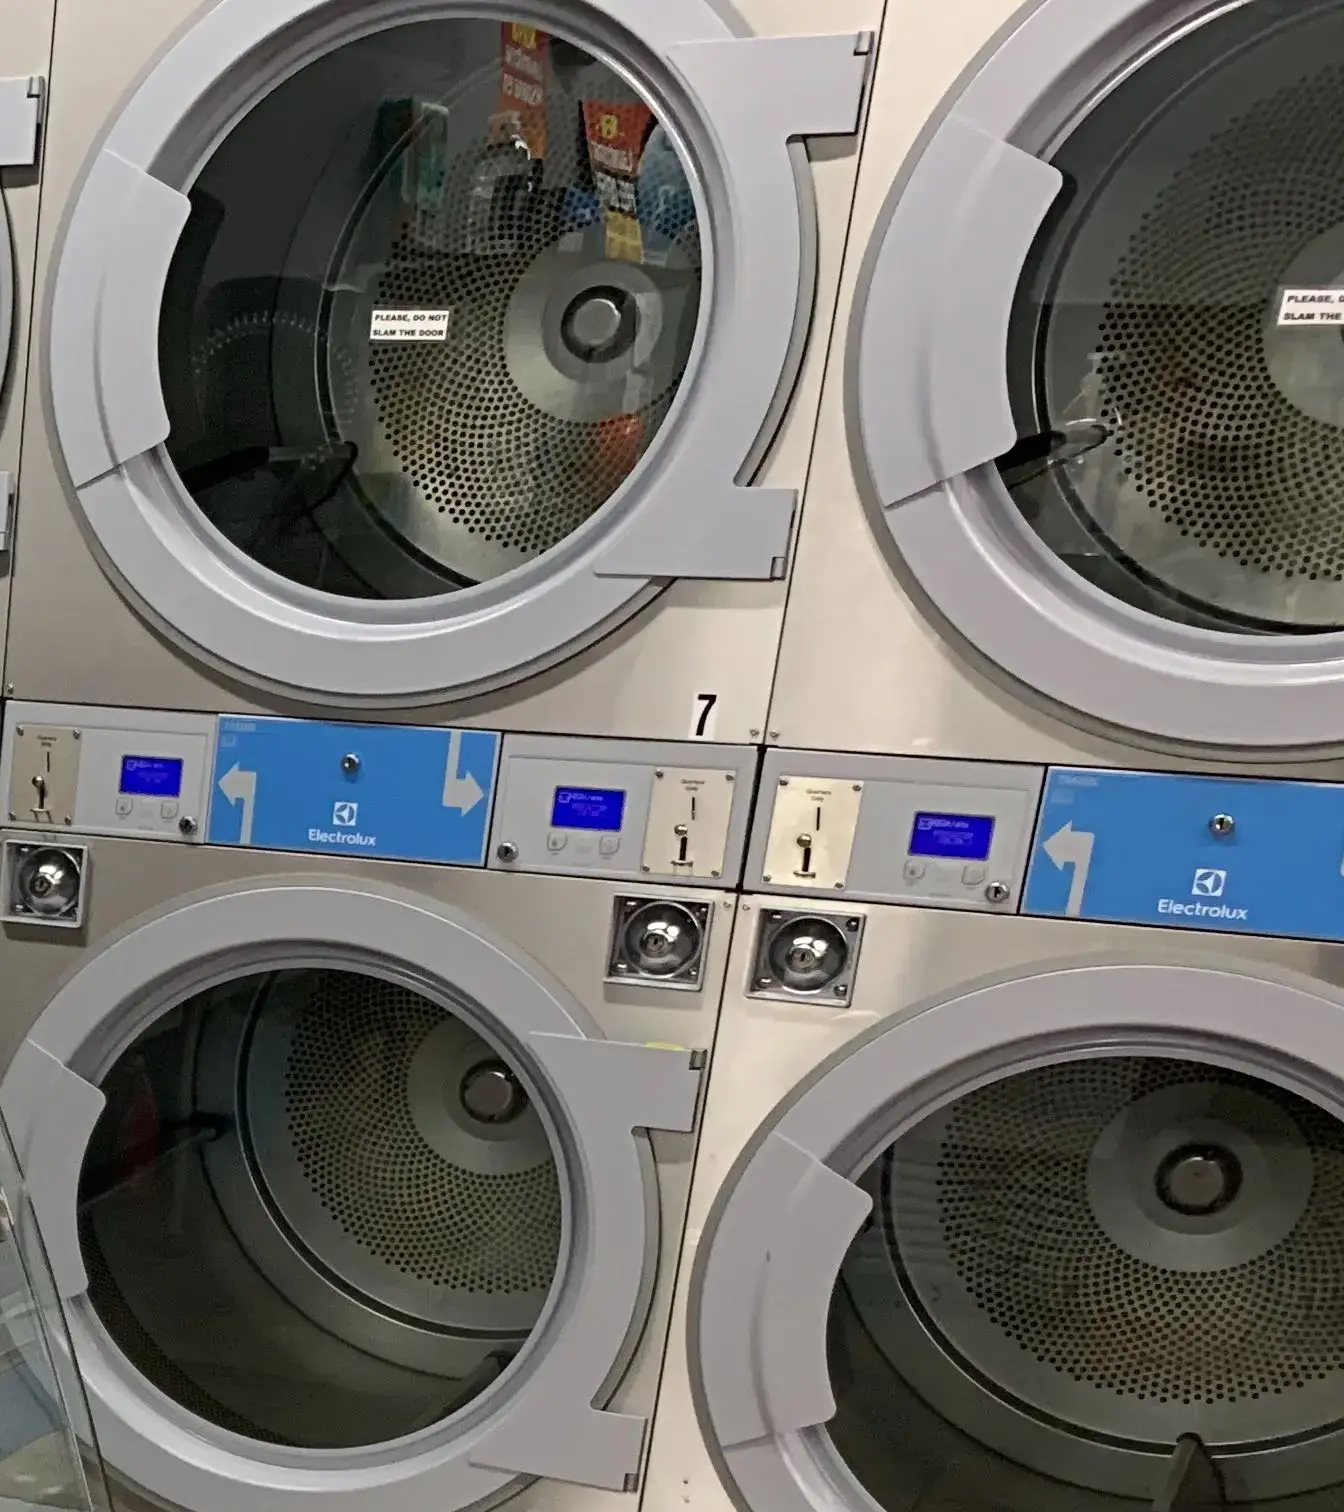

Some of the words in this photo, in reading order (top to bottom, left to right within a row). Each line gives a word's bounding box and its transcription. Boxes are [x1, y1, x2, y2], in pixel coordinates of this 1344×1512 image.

[1286, 295, 1335, 304] PLEASE,
[374, 314, 410, 322] PLEASE,
[1283, 312, 1316, 321] SLAM
[1319, 312, 1342, 320] THE
[372, 329, 396, 337] SLAM
[399, 329, 416, 337] THE
[418, 329, 444, 337] DOOR
[695, 693, 718, 737] 7
[308, 828, 377, 847] Electrolux
[1157, 898, 1249, 921] Electrolux
